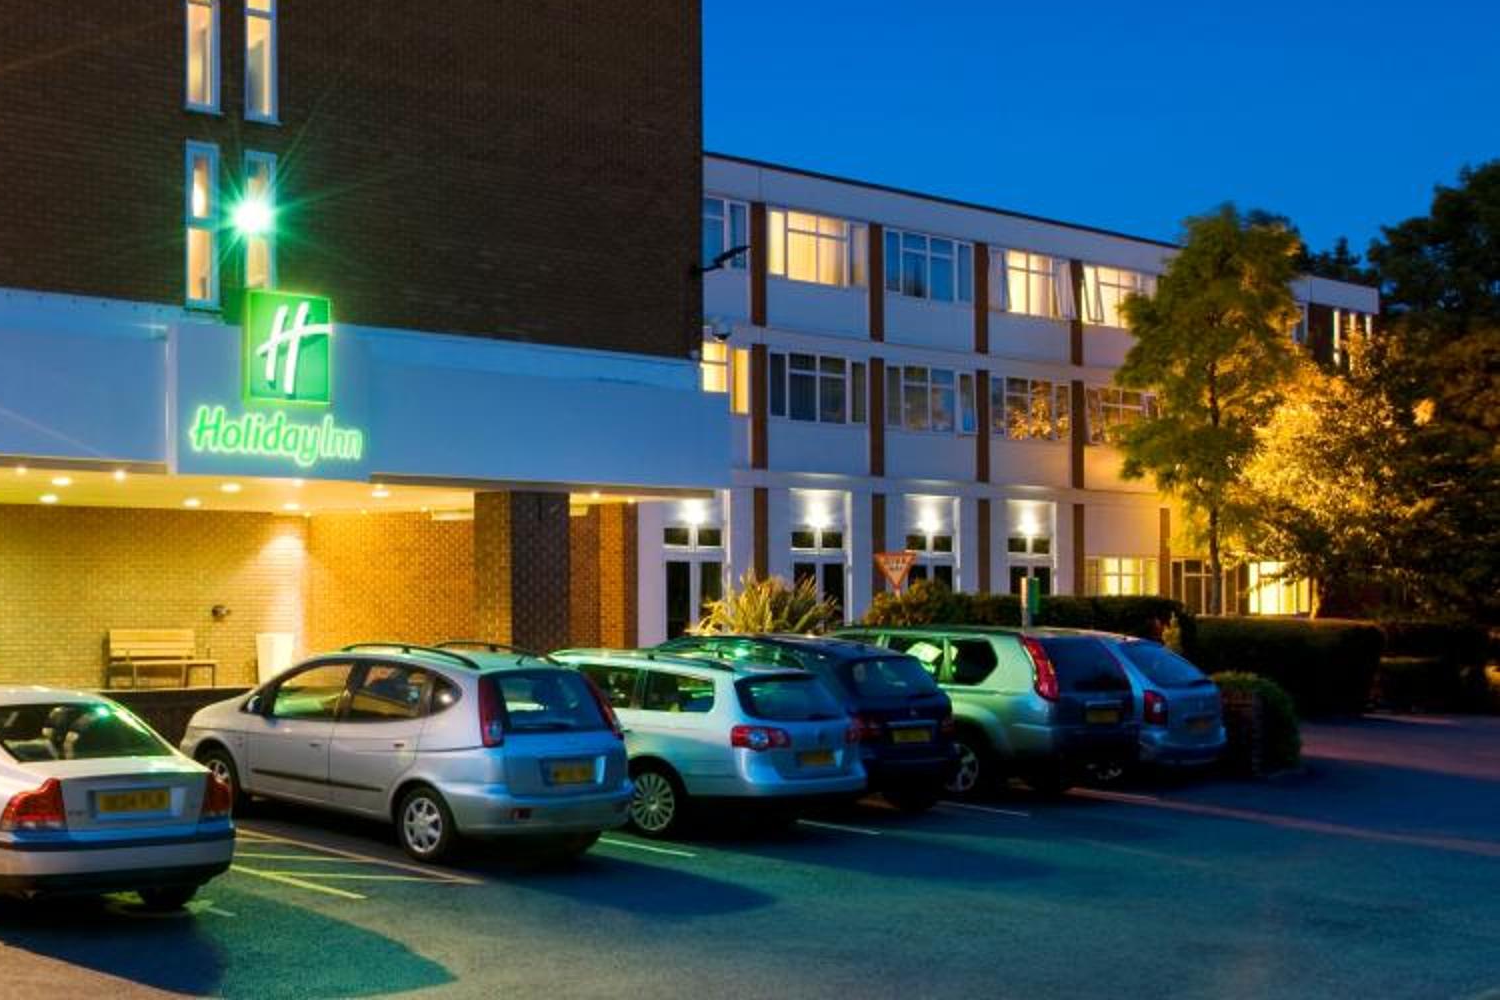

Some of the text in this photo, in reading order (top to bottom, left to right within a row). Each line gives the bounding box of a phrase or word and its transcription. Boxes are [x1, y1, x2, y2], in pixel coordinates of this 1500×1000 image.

[256, 301, 334, 394] H
[190, 405, 363, 466] Holiday Inn
